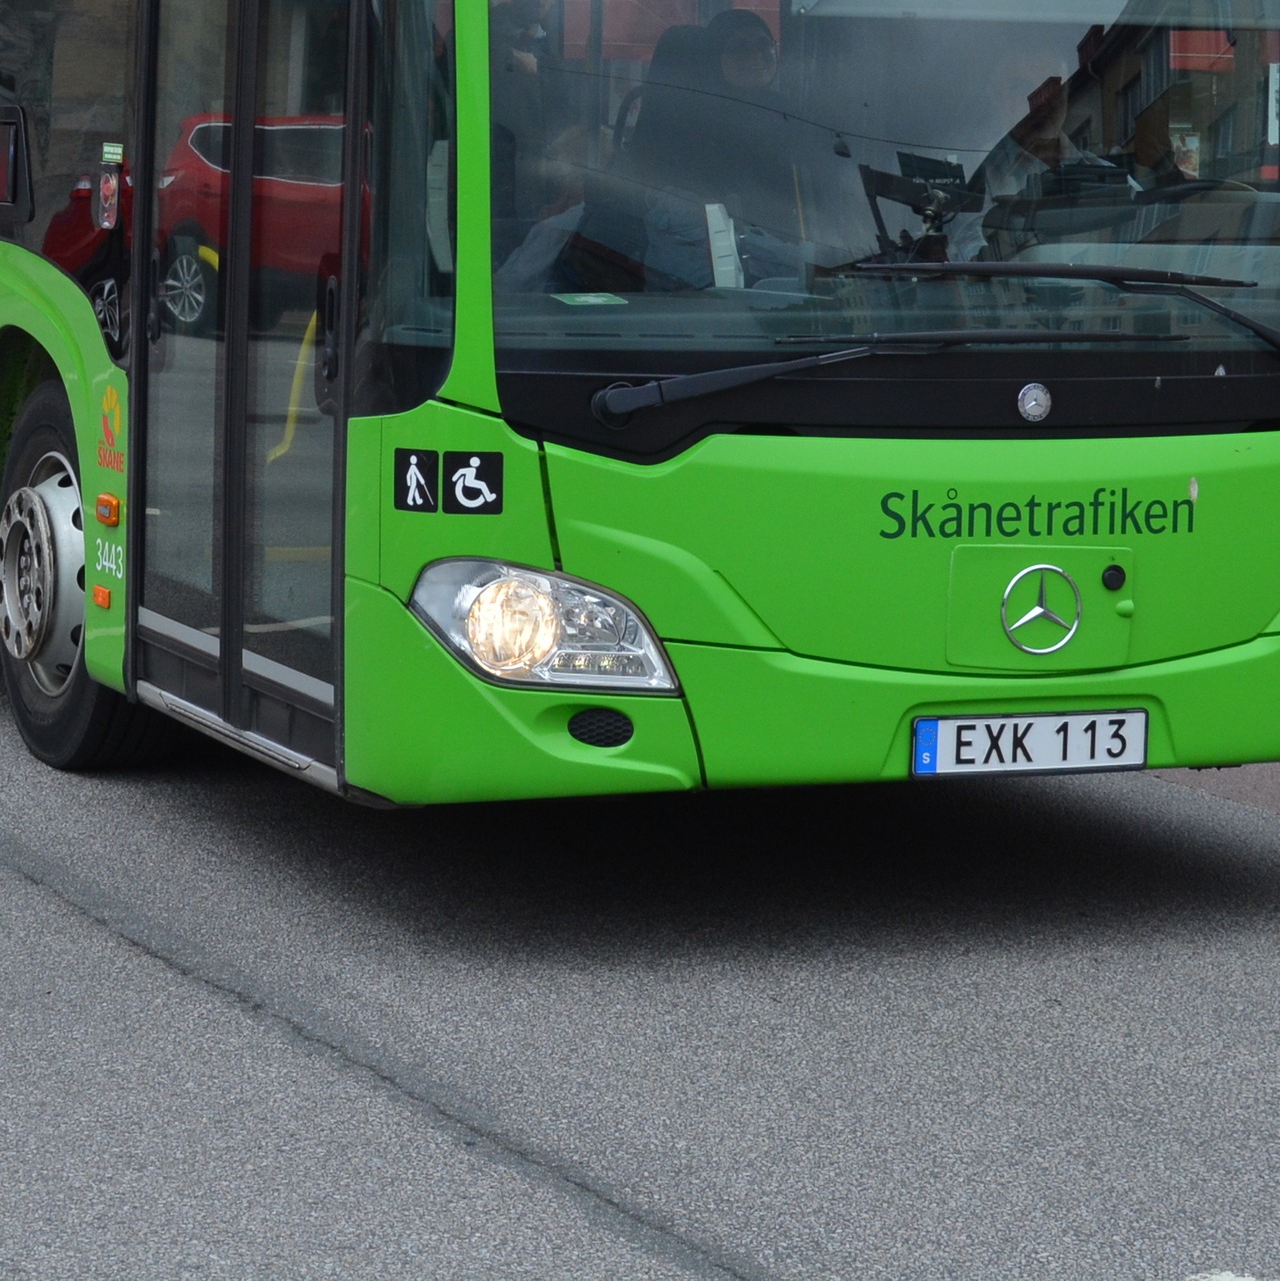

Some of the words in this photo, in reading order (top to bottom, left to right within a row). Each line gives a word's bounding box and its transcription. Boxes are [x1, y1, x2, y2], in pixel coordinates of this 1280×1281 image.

[878, 487, 1196, 540] Skånetrafiken
[95, 537, 124, 580] 3443
[921, 751, 931, 764] S
[955, 722, 1034, 765] EXK
[1054, 719, 1128, 761] 113
